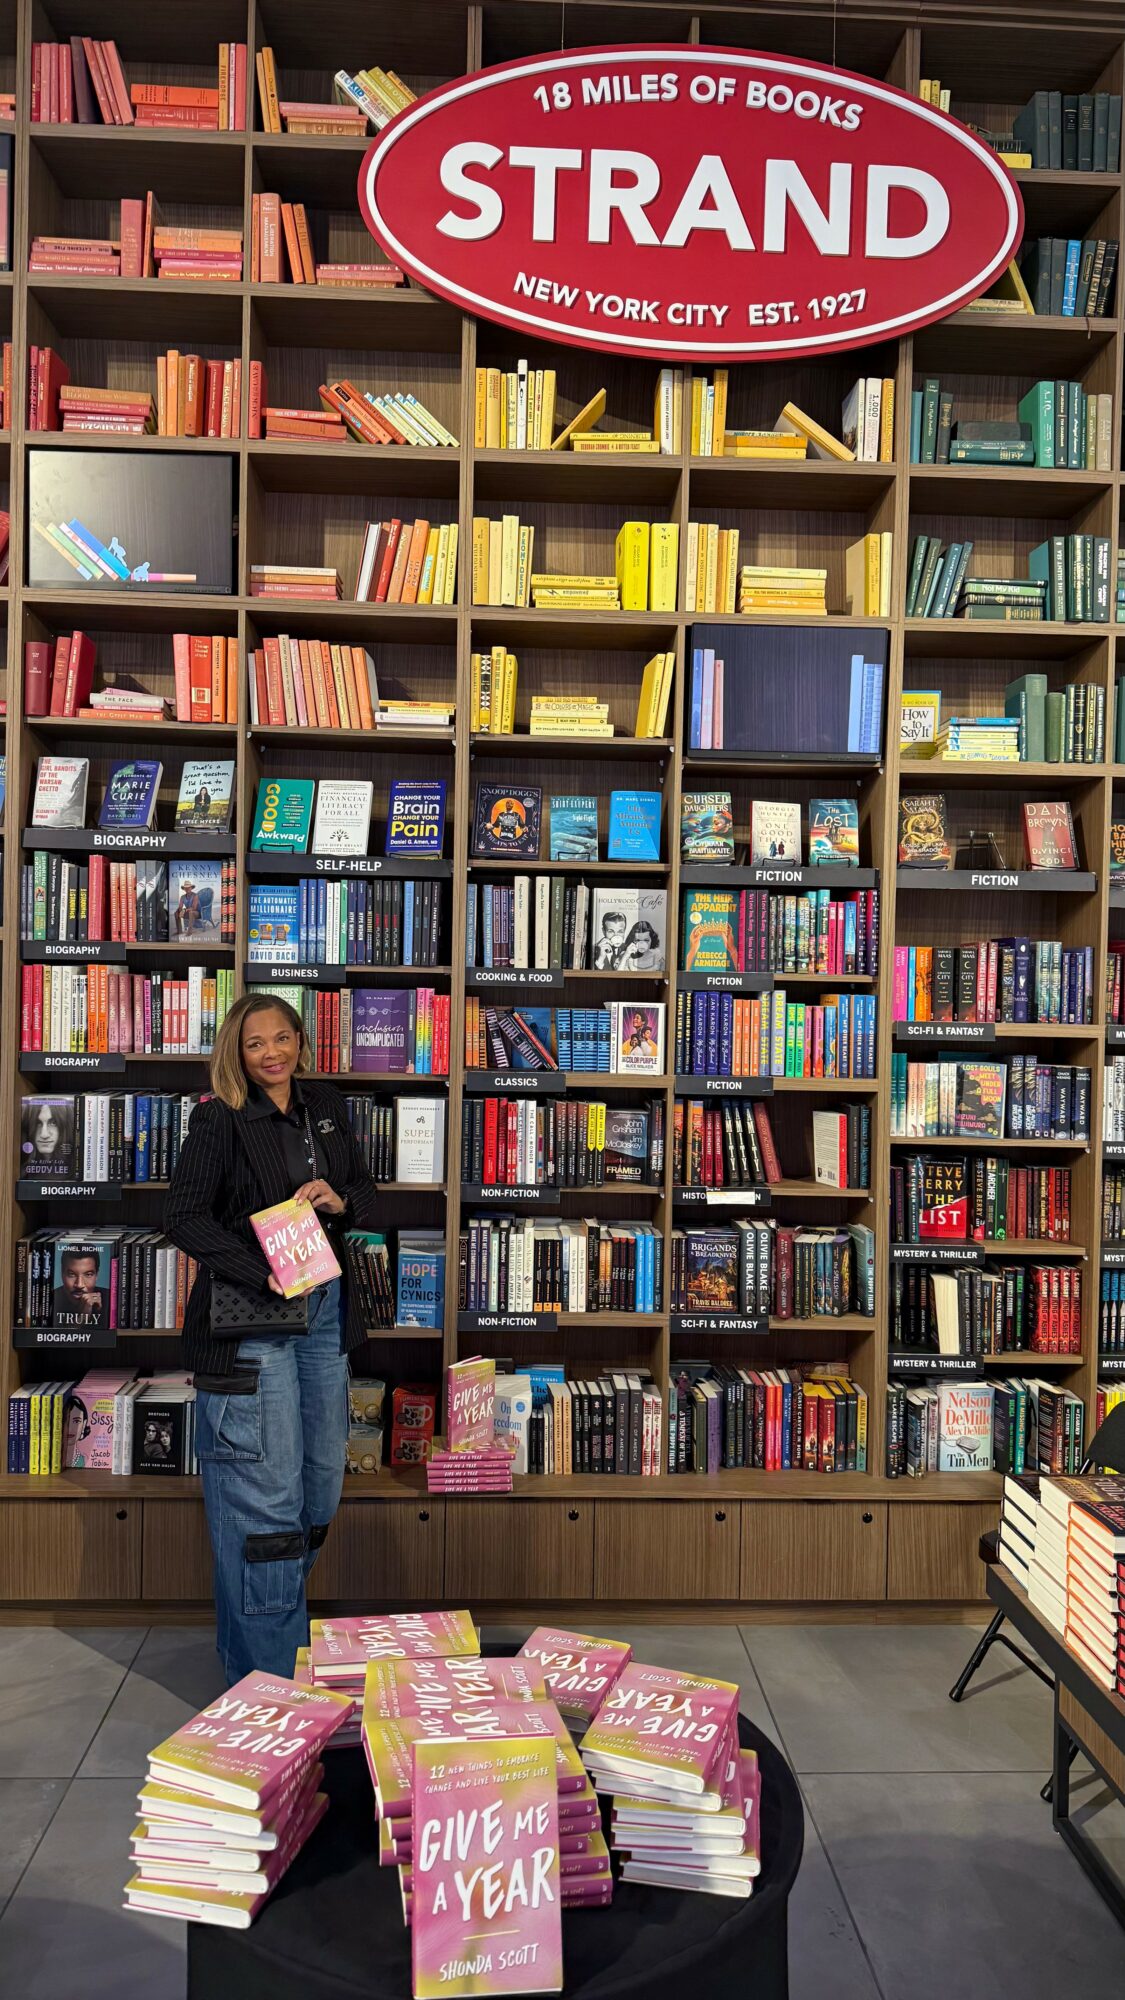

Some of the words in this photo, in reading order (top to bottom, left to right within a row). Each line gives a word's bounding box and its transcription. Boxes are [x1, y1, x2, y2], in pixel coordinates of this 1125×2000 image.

[534, 85, 572, 113] 18
[582, 74, 678, 105] MILES
[690, 75, 735, 105] OF
[746, 80, 864, 132] BOOKS
[436, 142, 950, 260] STRAND
[513, 271, 581, 308] NEW
[584, 290, 659, 324] YORK
[667, 302, 728, 327] CITY
[748, 302, 798, 327] EST.
[806, 288, 867, 320] 1927
[902, 709, 929, 720] How
[913, 720, 922, 728] to
[901, 726, 920, 740] Say
[922, 727, 929, 737] It
[112, 781, 151, 790] MARIE
[112, 792, 146, 801] CURIE
[684, 795, 729, 804] CURSED
[393, 801, 440, 815] Brain
[1026, 804, 1066, 816] DAN
[1028, 817, 1068, 828] BROWN
[390, 821, 438, 837] Pain
[94, 834, 167, 847] BIOGRAPHY
[256, 831, 305, 843] Awkward
[316, 860, 382, 871] SELF-HELP
[171, 871, 219, 879] CHESNEY
[756, 871, 802, 881] FICTION
[972, 875, 1019, 886] FICTION
[250, 896, 261, 904] THE
[263, 897, 297, 905] AUTOMATIC
[694, 893, 711, 902] THE
[713, 894, 733, 903] HEIR
[250, 905, 297, 914] MILLIONAIRE
[690, 903, 736, 913] APPARENT
[45, 946, 101, 955] BIOGRAPHY
[250, 952, 272, 961] DAVID
[276, 952, 296, 961] BACH
[271, 969, 319, 978] BUSINESS
[476, 972, 516, 981] COOKING
[528, 974, 553, 982] FOOD
[707, 977, 743, 985] FICTION
[356, 1020, 404, 1032] inclusion
[908, 1026, 934, 1035] SCI-FI
[936, 1027, 943, 1035] &
[946, 1027, 984, 1036] FANTASY
[356, 1032, 405, 1047] UNCOMPLICATED
[775, 1036, 783, 1064] STATE
[45, 1058, 100, 1067] BIOGRAPHY
[495, 1078, 538, 1086] CLASSICS
[706, 1082, 742, 1090] FICTION
[612, 1124, 643, 1133] Grisham
[624, 1120, 642, 1128] John
[26, 1165, 52, 1174] GEDDY
[54, 1165, 69, 1173] LEE
[606, 1167, 641, 1175] FRAMED
[41, 1186, 96, 1196] BIOGRAPHY
[481, 1188, 539, 1198] NON-FICTION
[925, 1194, 954, 1204] THE
[919, 1209, 960, 1225] LIST
[265, 1219, 299, 1256] GIVE
[300, 1215, 316, 1232] ME
[278, 1257, 286, 1268] A
[287, 1230, 327, 1266] YEAR
[691, 1243, 737, 1253] BRIGANDS
[760, 1233, 768, 1259] OLIVIE
[695, 1250, 737, 1259] BREADKNIVES
[894, 1250, 930, 1258] MYSTERY
[939, 1251, 978, 1259] THRILLER
[402, 1263, 438, 1277] HOPE
[746, 1263, 754, 1290] BLAKE
[760, 1262, 768, 1291] BLAKE
[401, 1278, 421, 1288] FOR
[401, 1290, 440, 1301] CYNICS
[56, 1312, 101, 1325] TRULY
[478, 1317, 537, 1326] NON-FICTION
[681, 1320, 708, 1328] SCI-FI
[710, 1320, 716, 1328] &
[719, 1320, 758, 1329] FANTASY
[37, 1333, 91, 1342] BIOGRAPHY
[893, 1360, 929, 1368] MYSTERY
[453, 1383, 480, 1412] GIVE
[482, 1382, 494, 1396] ME
[949, 1392, 990, 1408] Nelson
[457, 1415, 462, 1425] A
[464, 1399, 494, 1426] YEAR
[501, 1401, 511, 1413] On
[91, 1412, 114, 1433] Sissy
[494, 1419, 521, 1431] reedom
[946, 1426, 962, 1435] Alex
[513, 1431, 521, 1446] by
[91, 1450, 110, 1458] Jacob
[91, 1458, 109, 1468] Tobia
[947, 1454, 964, 1467] Tin
[967, 1454, 989, 1467] Men
[389, 1614, 435, 1639] GIVE
[358, 1627, 405, 1658] YEAR
[410, 1641, 436, 1654] ME
[639, 1672, 673, 1682] SCOTT
[253, 1684, 288, 1696] SCOTT
[677, 1677, 719, 1691] SHONDA
[288, 1687, 331, 1704] SHONDA
[607, 1688, 692, 1717] YEAR
[202, 1696, 296, 1732] YEAR
[701, 1706, 715, 1716] A
[601, 1713, 636, 1726] ME
[184, 1721, 226, 1737] ME
[294, 1720, 313, 1732] A
[638, 1716, 719, 1743] GIVE
[217, 1727, 307, 1757] GIVE
[430, 1765, 445, 1779] 12
[448, 1766, 466, 1774] NEW
[468, 1762, 493, 1771] THINGS
[506, 1753, 540, 1766] EMBRACE
[425, 1782, 452, 1794] CHANGE
[456, 1778, 471, 1788] AND
[473, 1775, 491, 1786] LIVE
[493, 1773, 511, 1783] YOUR
[512, 1770, 531, 1780] BEST
[533, 1767, 549, 1777] LIFE
[419, 1799, 504, 1872] GIVE
[513, 1801, 549, 1841] ME
[432, 1881, 447, 1915] A
[454, 1847, 555, 1921] YEAR
[439, 1954, 493, 1982] SHONDA
[498, 1943, 539, 1969] SCOTT
